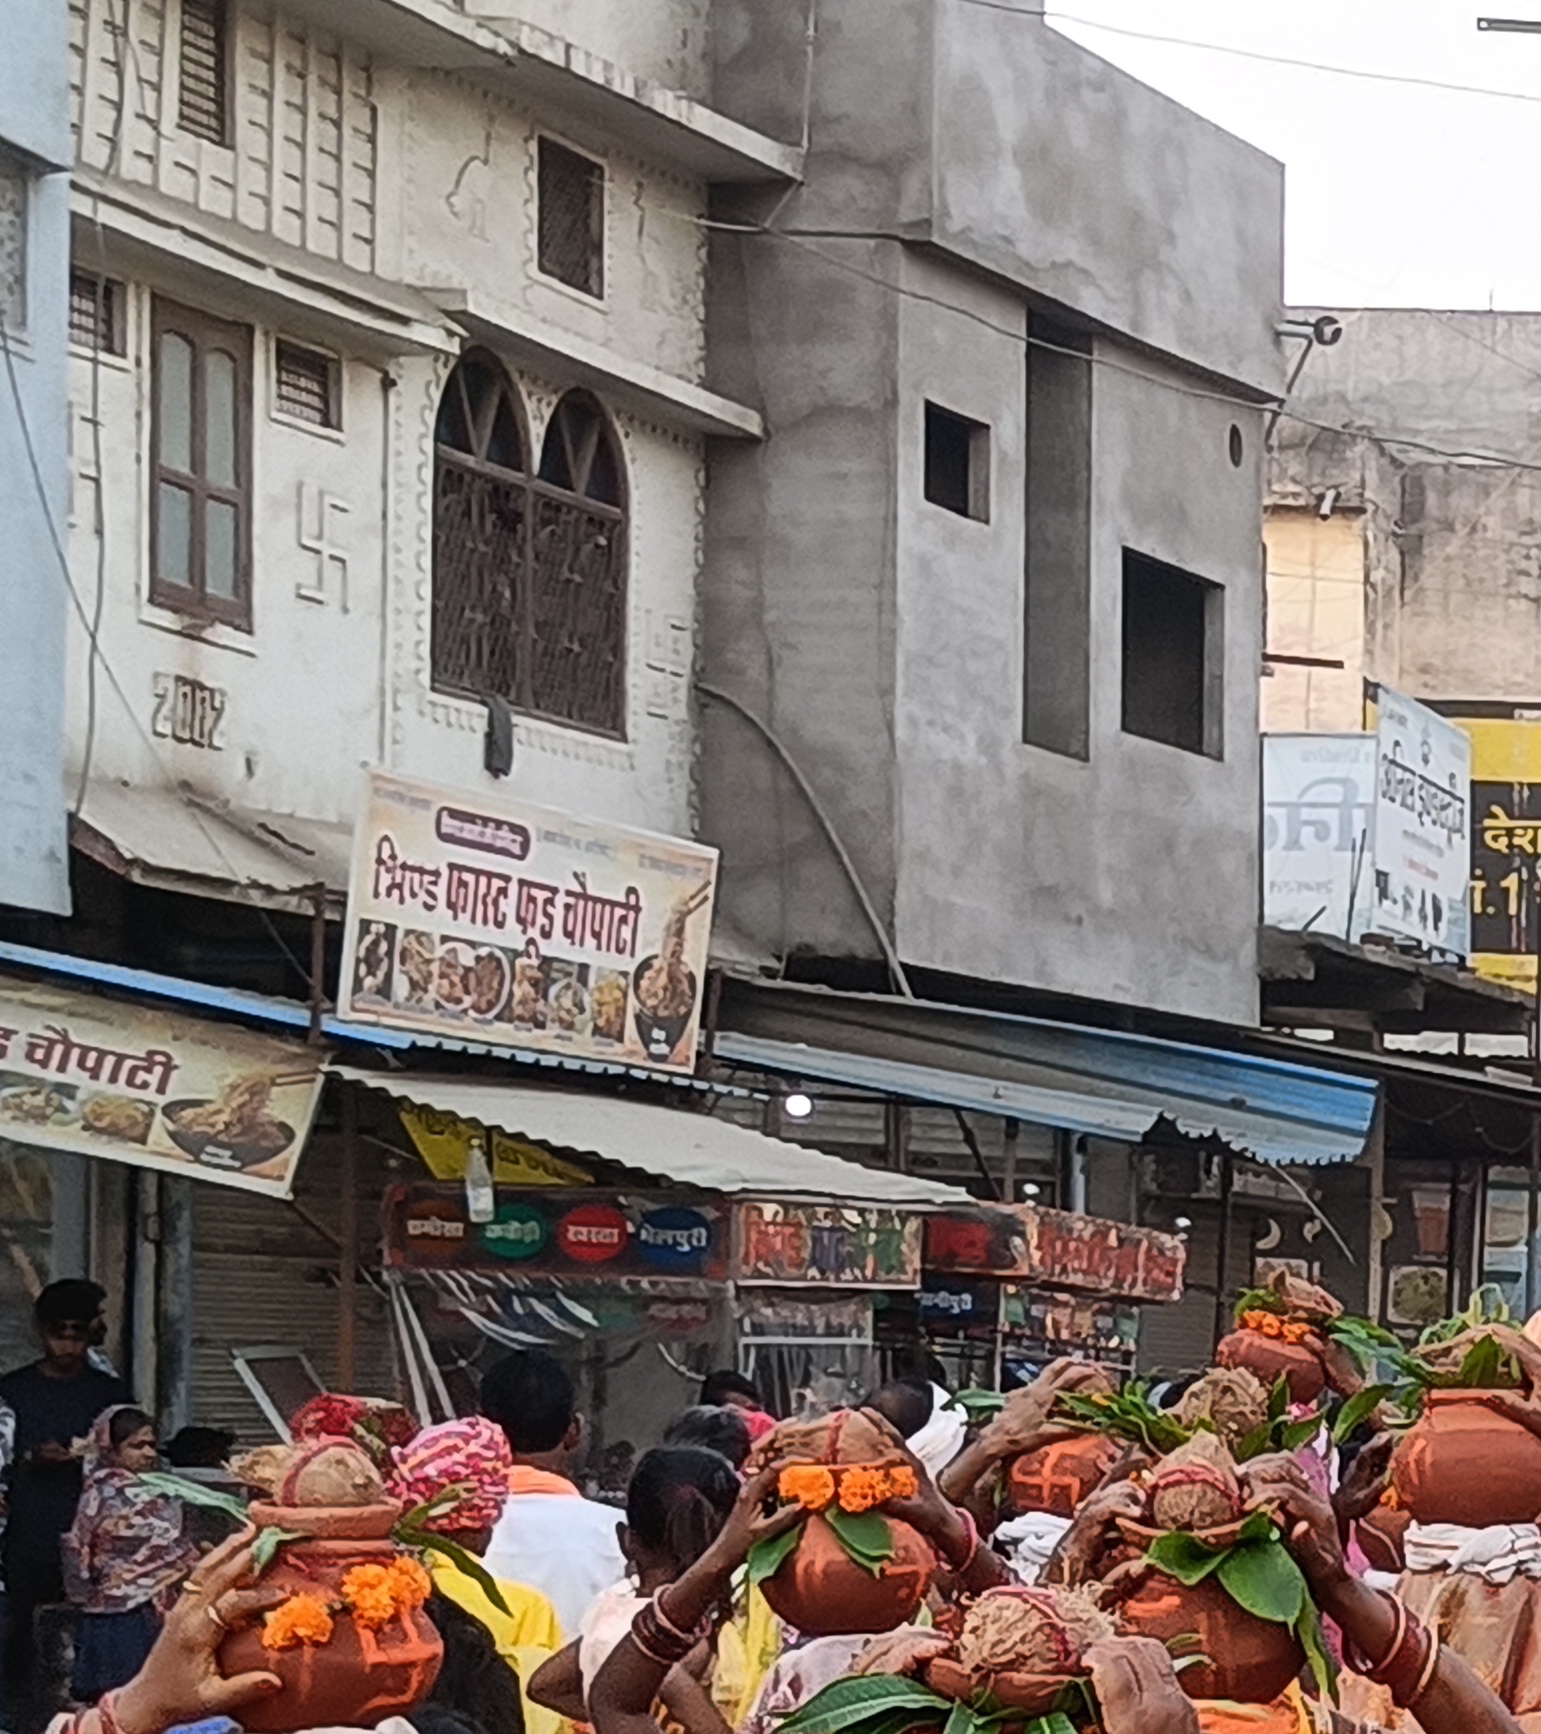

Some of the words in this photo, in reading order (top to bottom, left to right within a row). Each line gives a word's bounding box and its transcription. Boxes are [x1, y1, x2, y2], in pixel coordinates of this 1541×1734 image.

[446, 862, 513, 930] फास्ट
[563, 870, 643, 958] चौपाटी
[24, 1024, 180, 1096] चौपाटी
